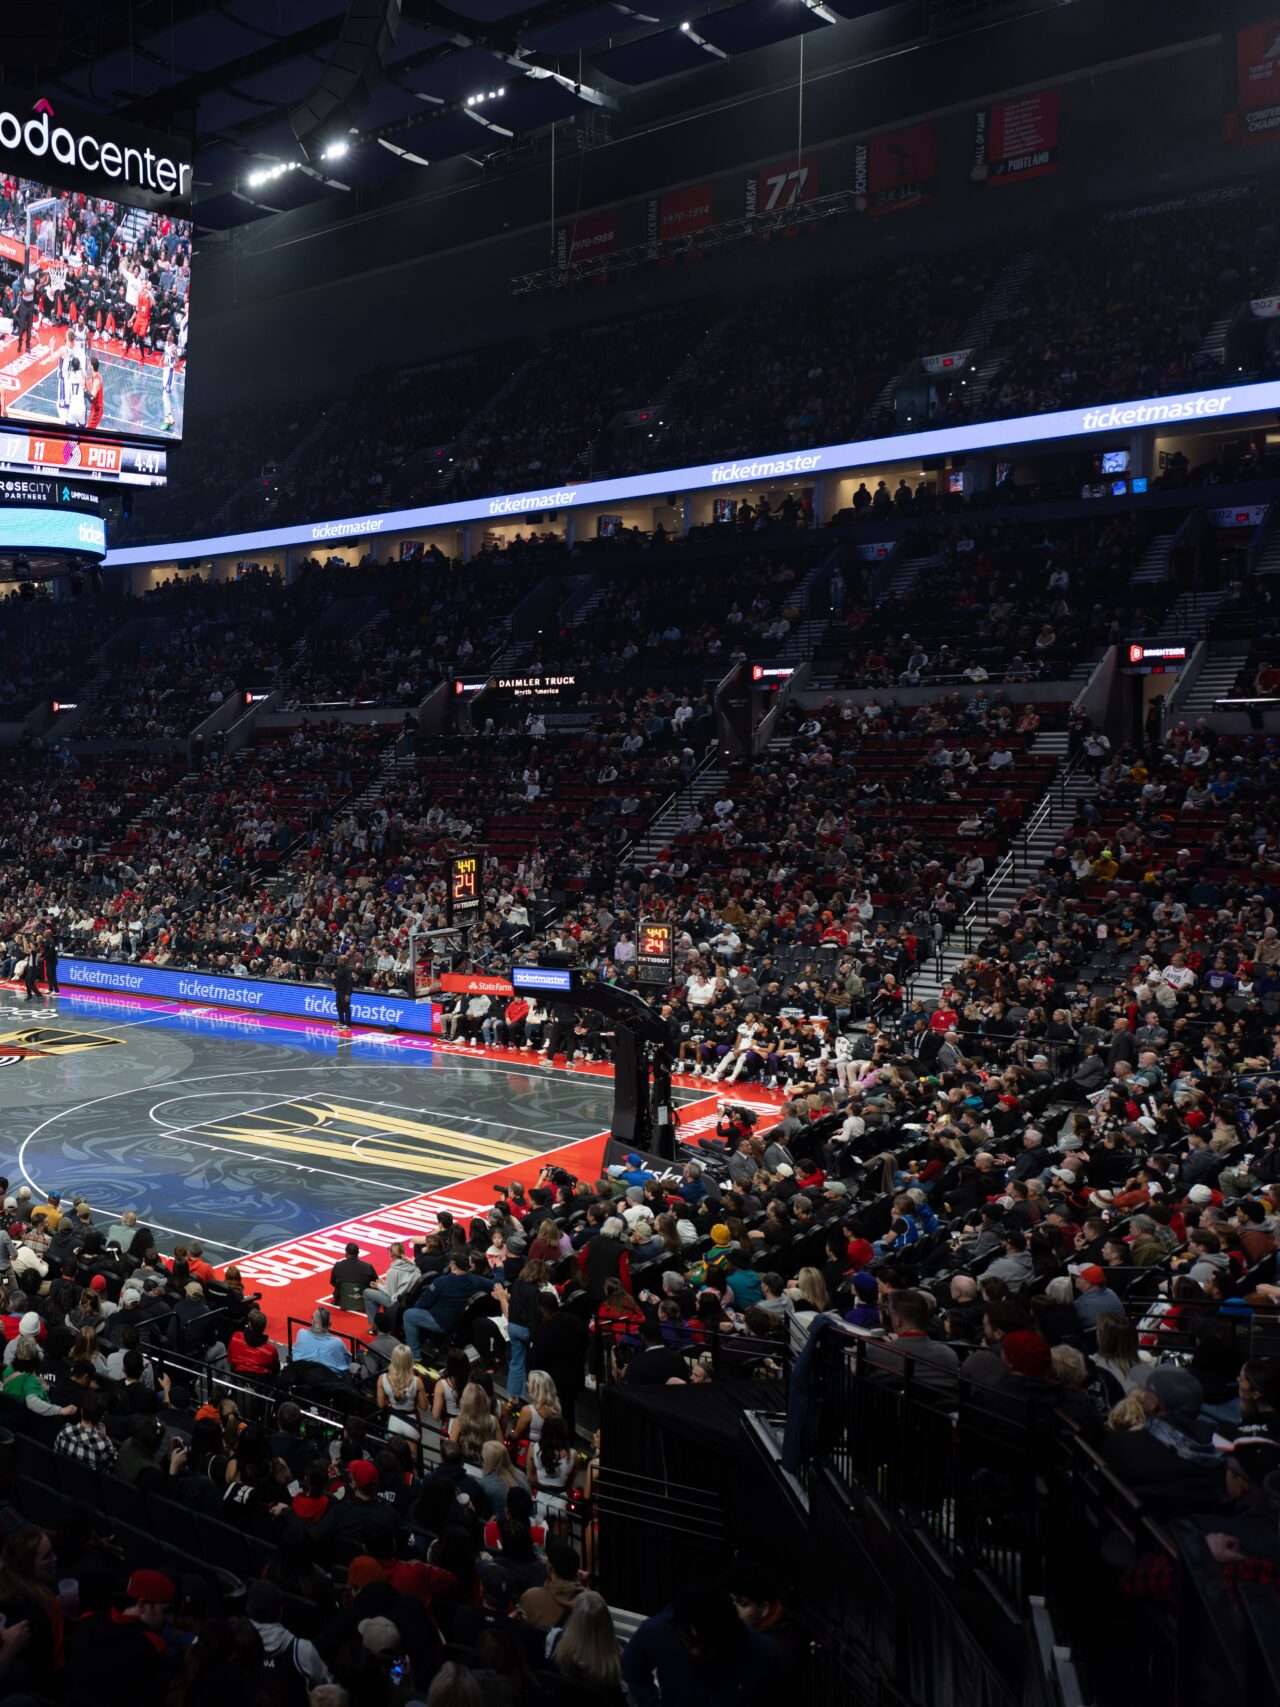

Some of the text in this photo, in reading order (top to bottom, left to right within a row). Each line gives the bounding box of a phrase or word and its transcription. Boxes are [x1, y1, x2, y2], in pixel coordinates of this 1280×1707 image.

[1008, 151, 1049, 172] PORTLAND
[745, 178, 758, 218] RAMSAY
[764, 167, 808, 212] 77
[1082, 396, 1232, 429] ticketmaster
[33, 441, 45, 461] 11
[88, 446, 116, 469] POR
[134, 455, 160, 474] 4:47
[710, 454, 821, 484] ticketmaster
[5, 492, 47, 501] PARTNERS
[489, 490, 577, 515] ticketmaster
[312, 518, 384, 539] ticketmaster
[1143, 647, 1186, 658] BRIGHTSIDE
[499, 676, 576, 688] DAIMLER TRUCK
[457, 859, 476, 873] 4:47
[455, 873, 474, 898] 24
[460, 900, 480, 909] TISSOT
[646, 928, 668, 939] 4:47
[645, 939, 664, 952] 24
[69, 965, 144, 990] ticketmaster
[516, 973, 567, 986] ticketmaster
[178, 979, 263, 1006] ticketmaster
[400, 1038, 486, 1055] TOYOTA
